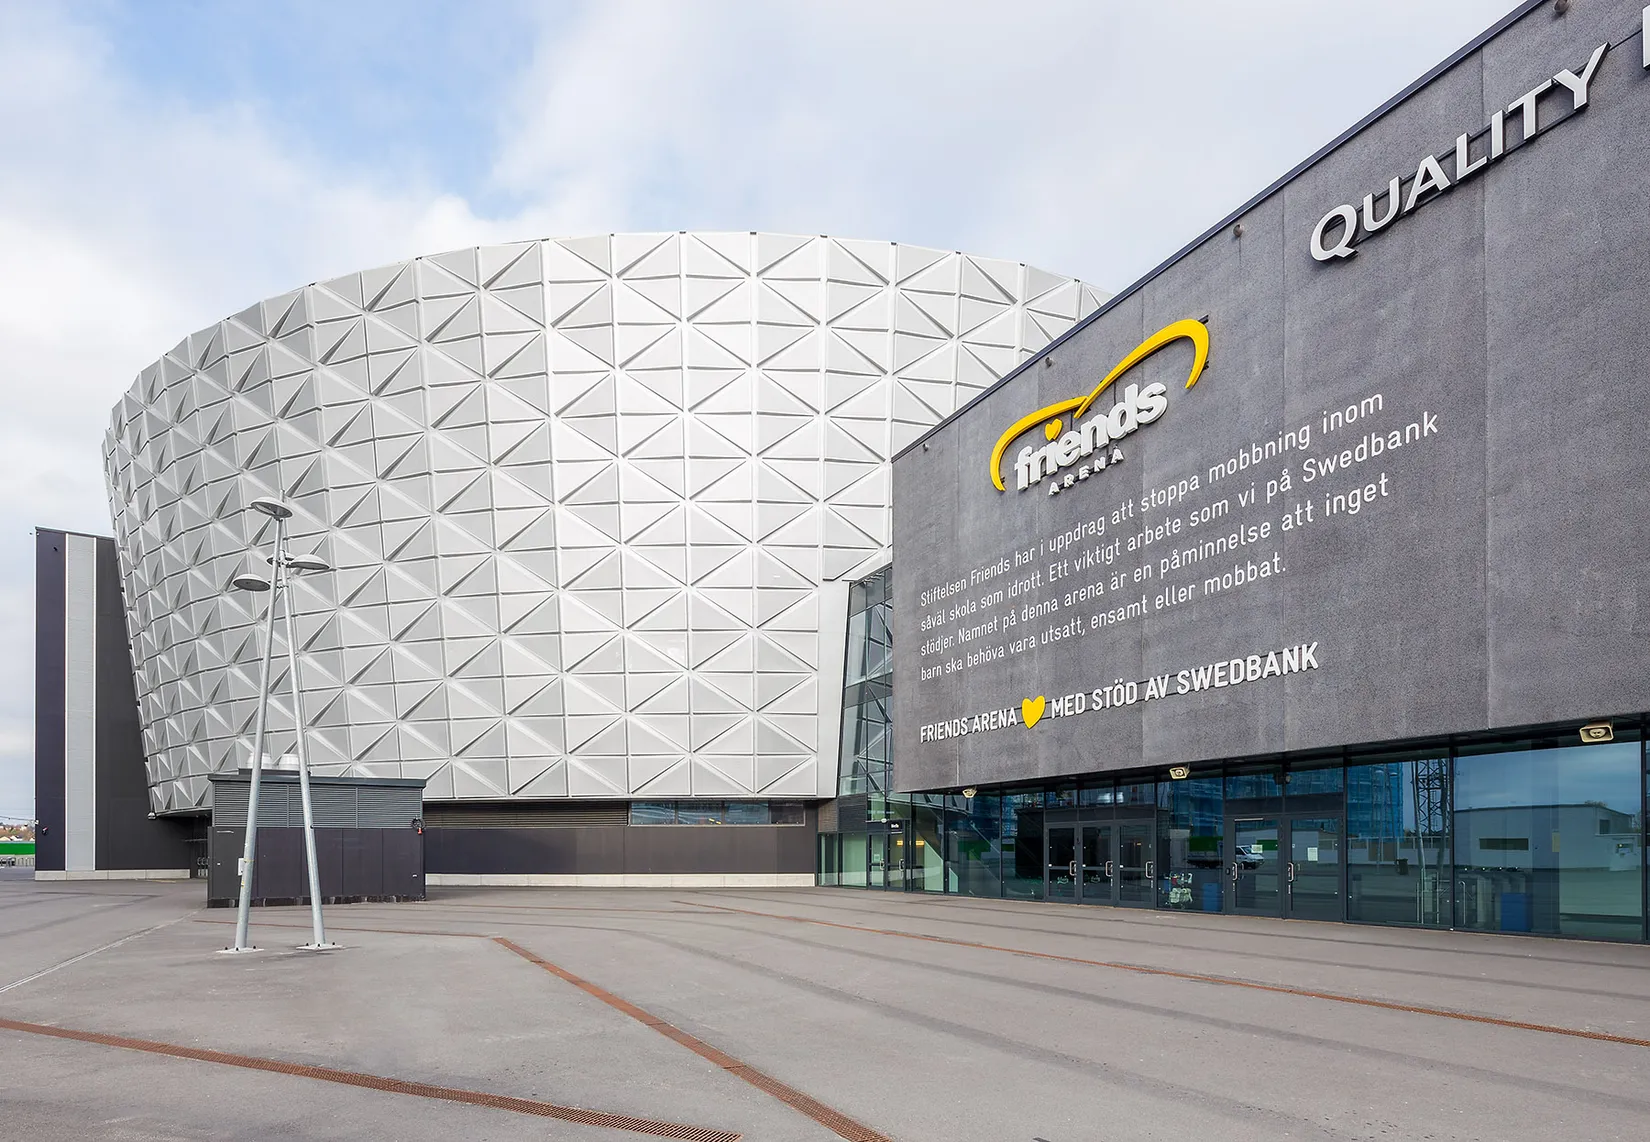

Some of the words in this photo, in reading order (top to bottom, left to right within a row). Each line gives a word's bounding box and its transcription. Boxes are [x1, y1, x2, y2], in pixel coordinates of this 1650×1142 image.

[1310, 42, 1611, 261] QUALITY
[920, 578, 967, 607] Stiftelsen
[970, 556, 1011, 587] Friends
[1014, 547, 1036, 568] har
[1040, 539, 1044, 557] i
[1049, 515, 1105, 554] uppdrag
[1111, 498, 1134, 525] att
[1140, 474, 1201, 513] stoppa
[1208, 424, 1311, 484] mobbning
[1322, 393, 1383, 435] inom
[1014, 382, 1168, 490] friends
[1048, 448, 1125, 496] ARENA
[920, 608, 946, 632] såväl
[949, 598, 977, 621] skola
[980, 590, 1004, 609] som
[1007, 569, 1045, 599] idrott.
[1049, 558, 1069, 583] Ett
[1073, 537, 1121, 572] viktigt
[1127, 516, 1182, 552] arbete
[1189, 499, 1229, 527] som
[1237, 481, 1255, 508] vi
[1266, 468, 1293, 505] på
[1302, 410, 1438, 483] Swedbank
[920, 635, 956, 657] stödjer.
[958, 615, 998, 645] Namnet
[1002, 609, 1017, 634] på
[1021, 598, 1059, 622] denna
[1064, 581, 1105, 607] arena
[1110, 570, 1127, 591] är
[1133, 564, 1152, 583] en
[1160, 521, 1271, 580] påminnelse
[1281, 499, 1314, 532] att
[1325, 472, 1389, 517] inget
[920, 662, 942, 681] barn
[945, 657, 964, 674] ska
[967, 645, 1005, 668] behöva
[1008, 635, 1037, 655] vara
[1041, 615, 1086, 645] utsatt,
[1090, 594, 1148, 630] ensamt
[1155, 584, 1196, 610] eller
[1204, 551, 1287, 596] mobbat.
[1051, 692, 1086, 719] MED
[1091, 677, 1138, 711] STÖD
[1144, 673, 1170, 702] AV
[1177, 641, 1319, 695] SWEDBANK
[920, 715, 970, 744] FRIENDS
[971, 706, 1018, 734] ARENA
